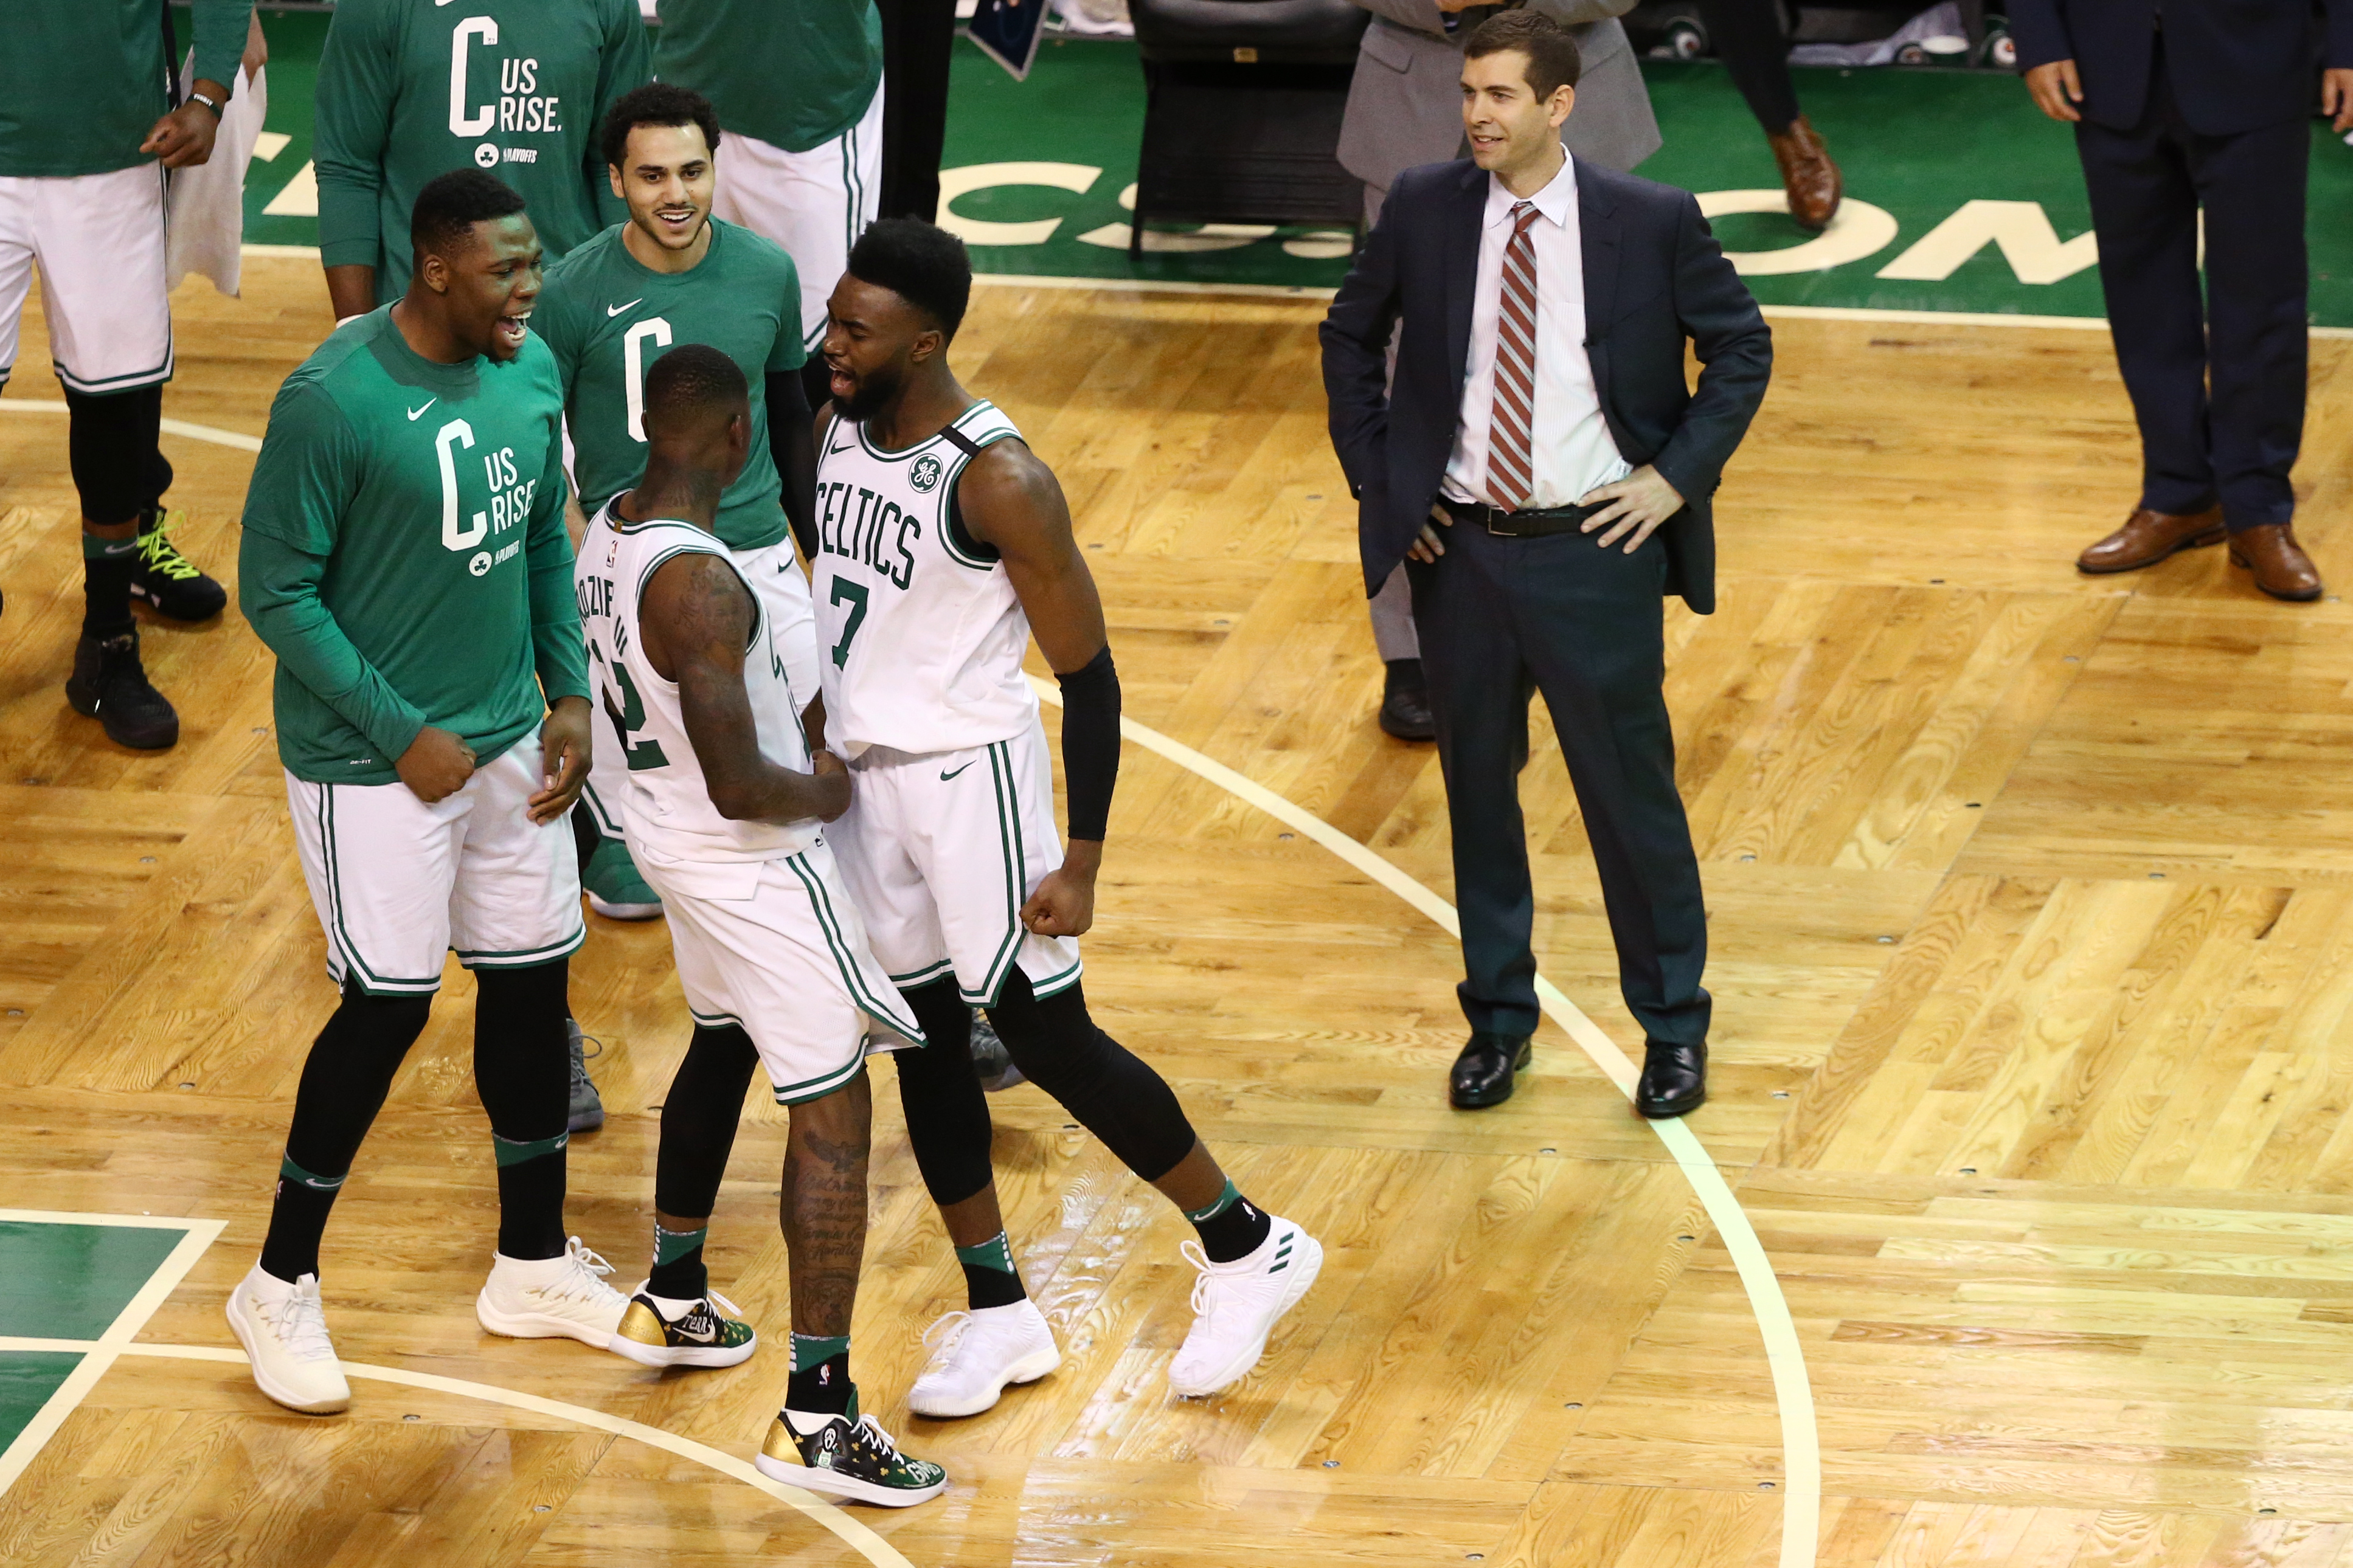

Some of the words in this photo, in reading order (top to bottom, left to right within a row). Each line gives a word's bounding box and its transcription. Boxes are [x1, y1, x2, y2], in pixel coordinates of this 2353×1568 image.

[449, 16, 498, 137] C
[501, 58, 538, 94] US
[501, 96, 562, 132] RISE.
[435, 418, 488, 551] C
[484, 447, 518, 492] US
[830, 574, 869, 672] 7
